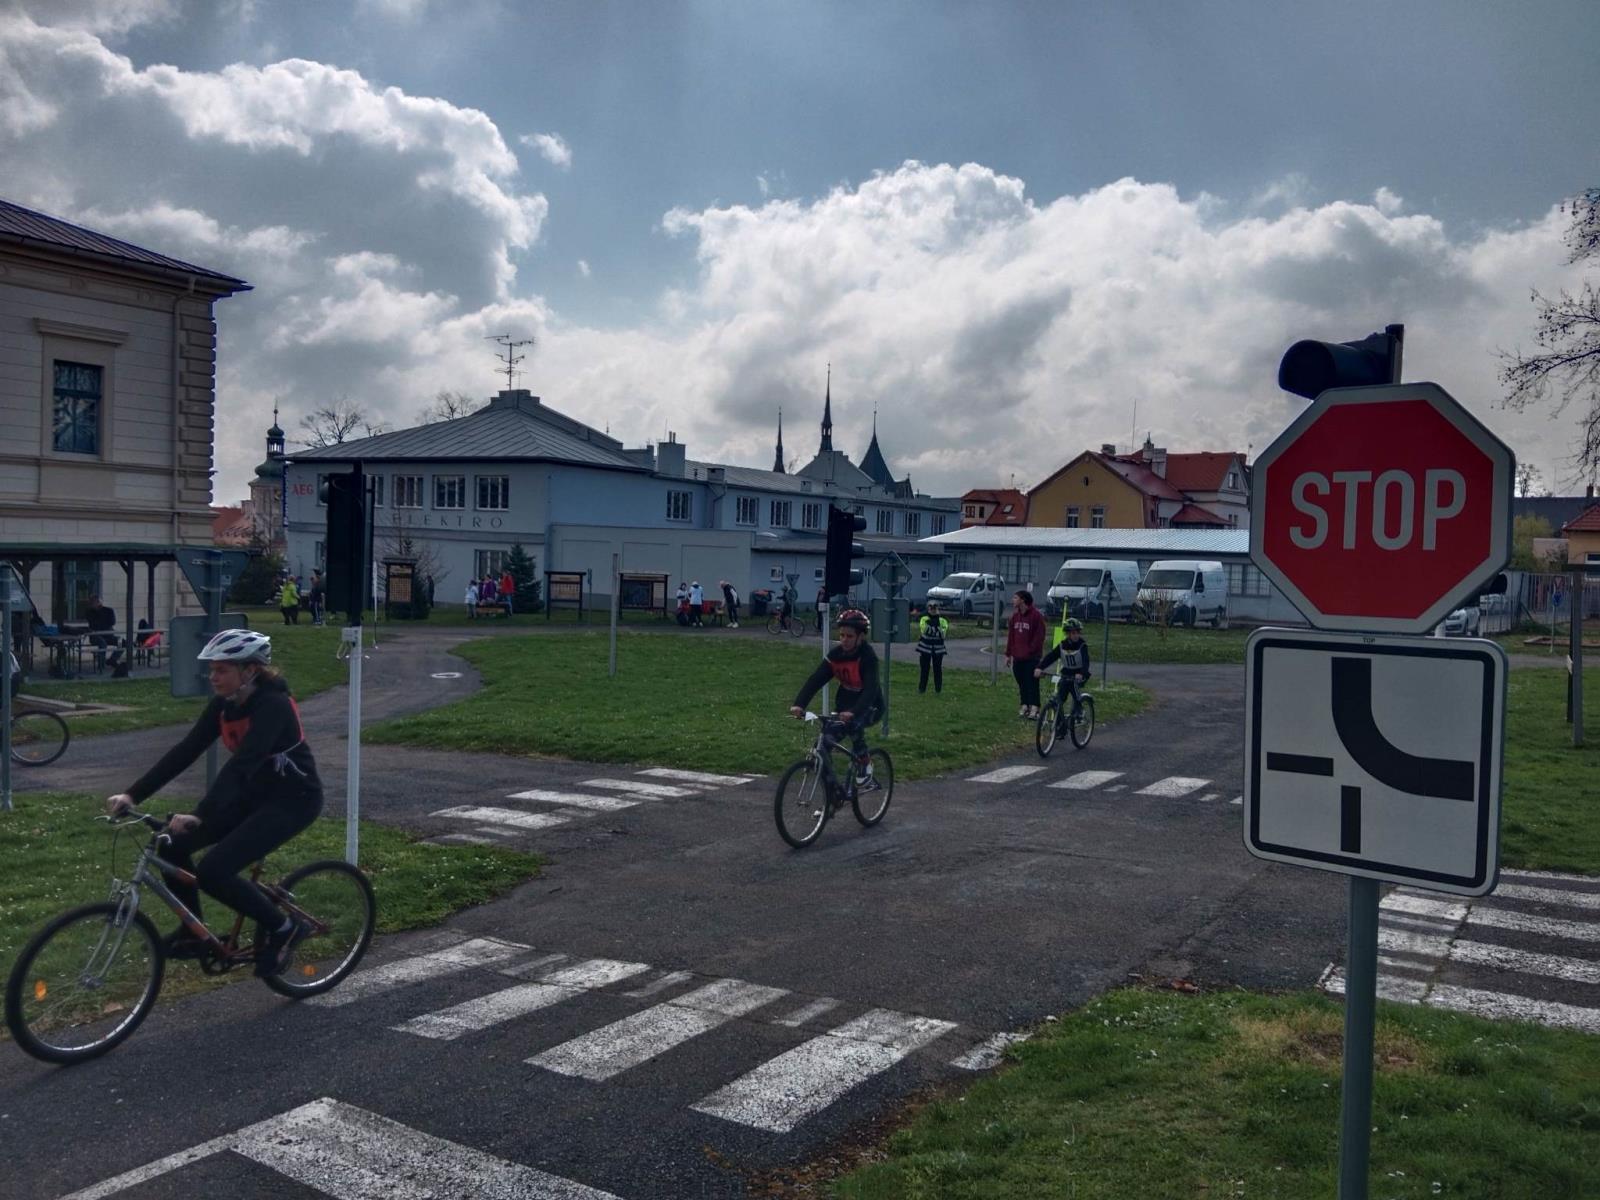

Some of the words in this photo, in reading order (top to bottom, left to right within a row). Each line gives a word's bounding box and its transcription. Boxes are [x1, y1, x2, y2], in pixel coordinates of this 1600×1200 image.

[292, 483, 314, 496] AEG
[1290, 469, 1467, 551] STOP
[393, 513, 503, 529] ELEKTRO
